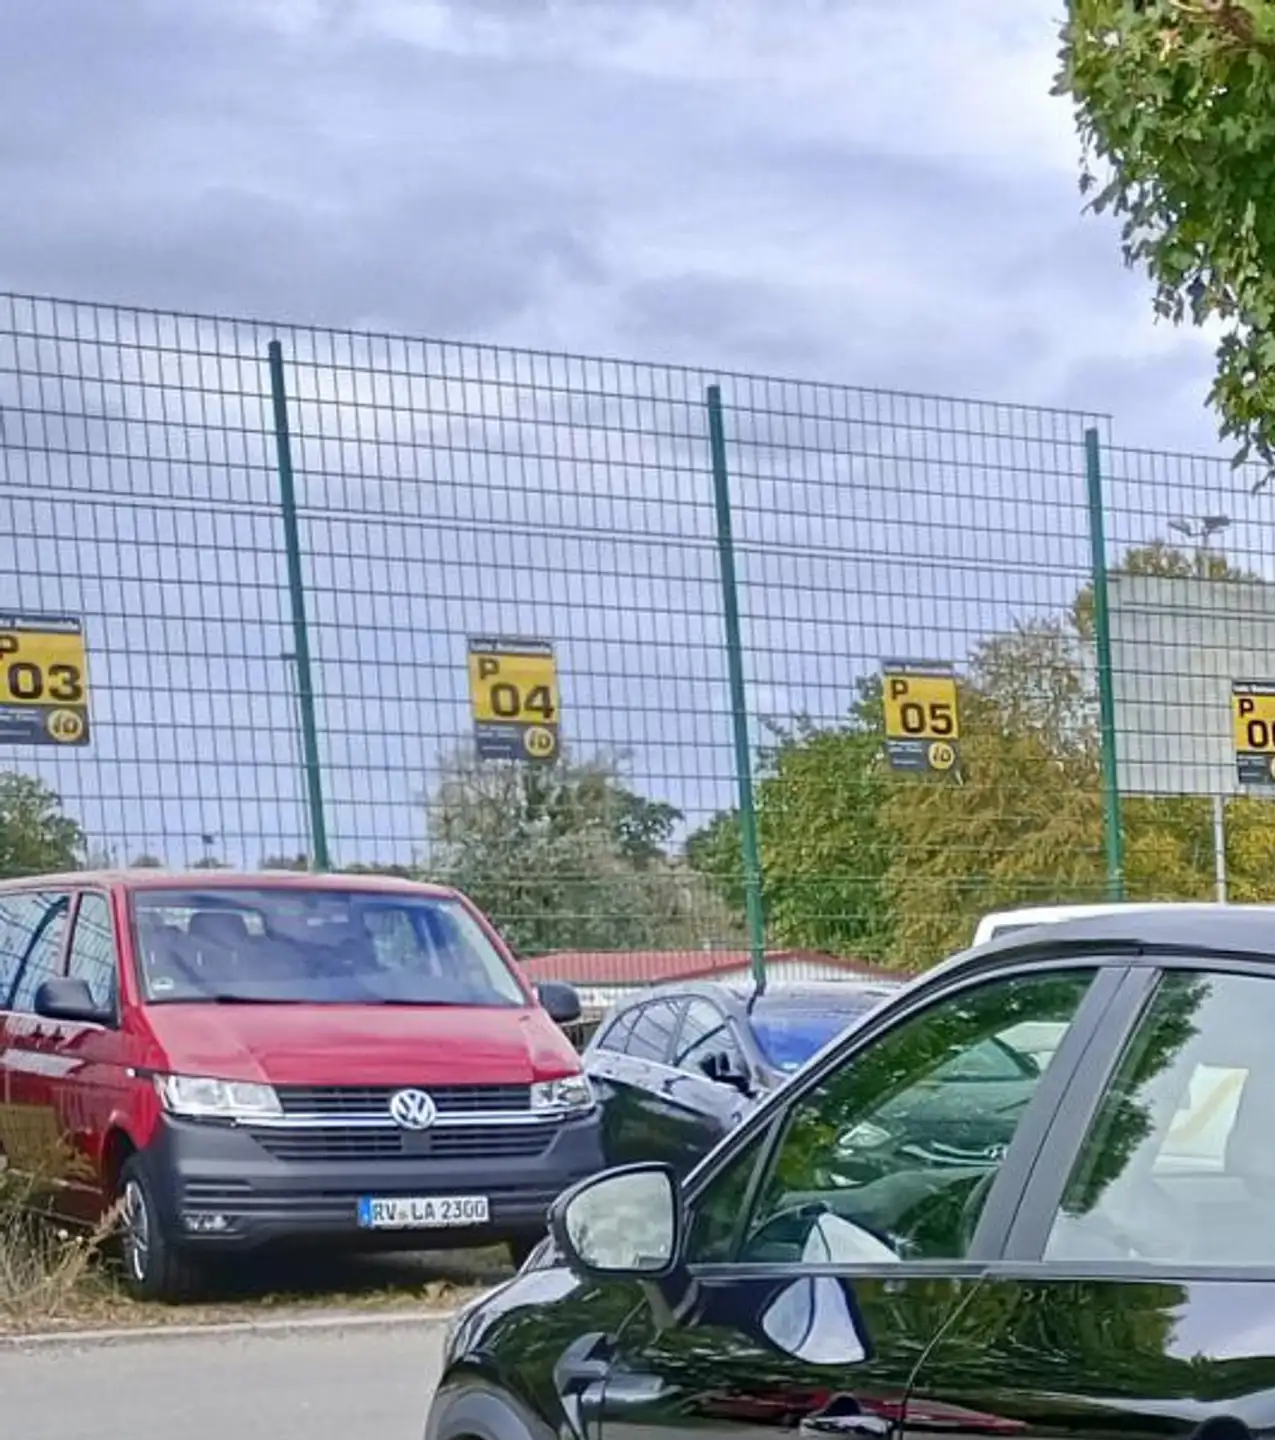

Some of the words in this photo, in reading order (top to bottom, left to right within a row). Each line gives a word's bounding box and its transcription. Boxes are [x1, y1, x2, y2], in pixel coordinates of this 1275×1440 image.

[478, 657, 499, 680] P
[8, 662, 83, 702] 03
[890, 680, 908, 700] P
[491, 683, 555, 719] 04
[1239, 698, 1254, 718] P
[901, 703, 953, 735] 05
[373, 1203, 397, 1220] RV
[411, 1202, 435, 1220] LA
[441, 1200, 486, 1219] 2300
